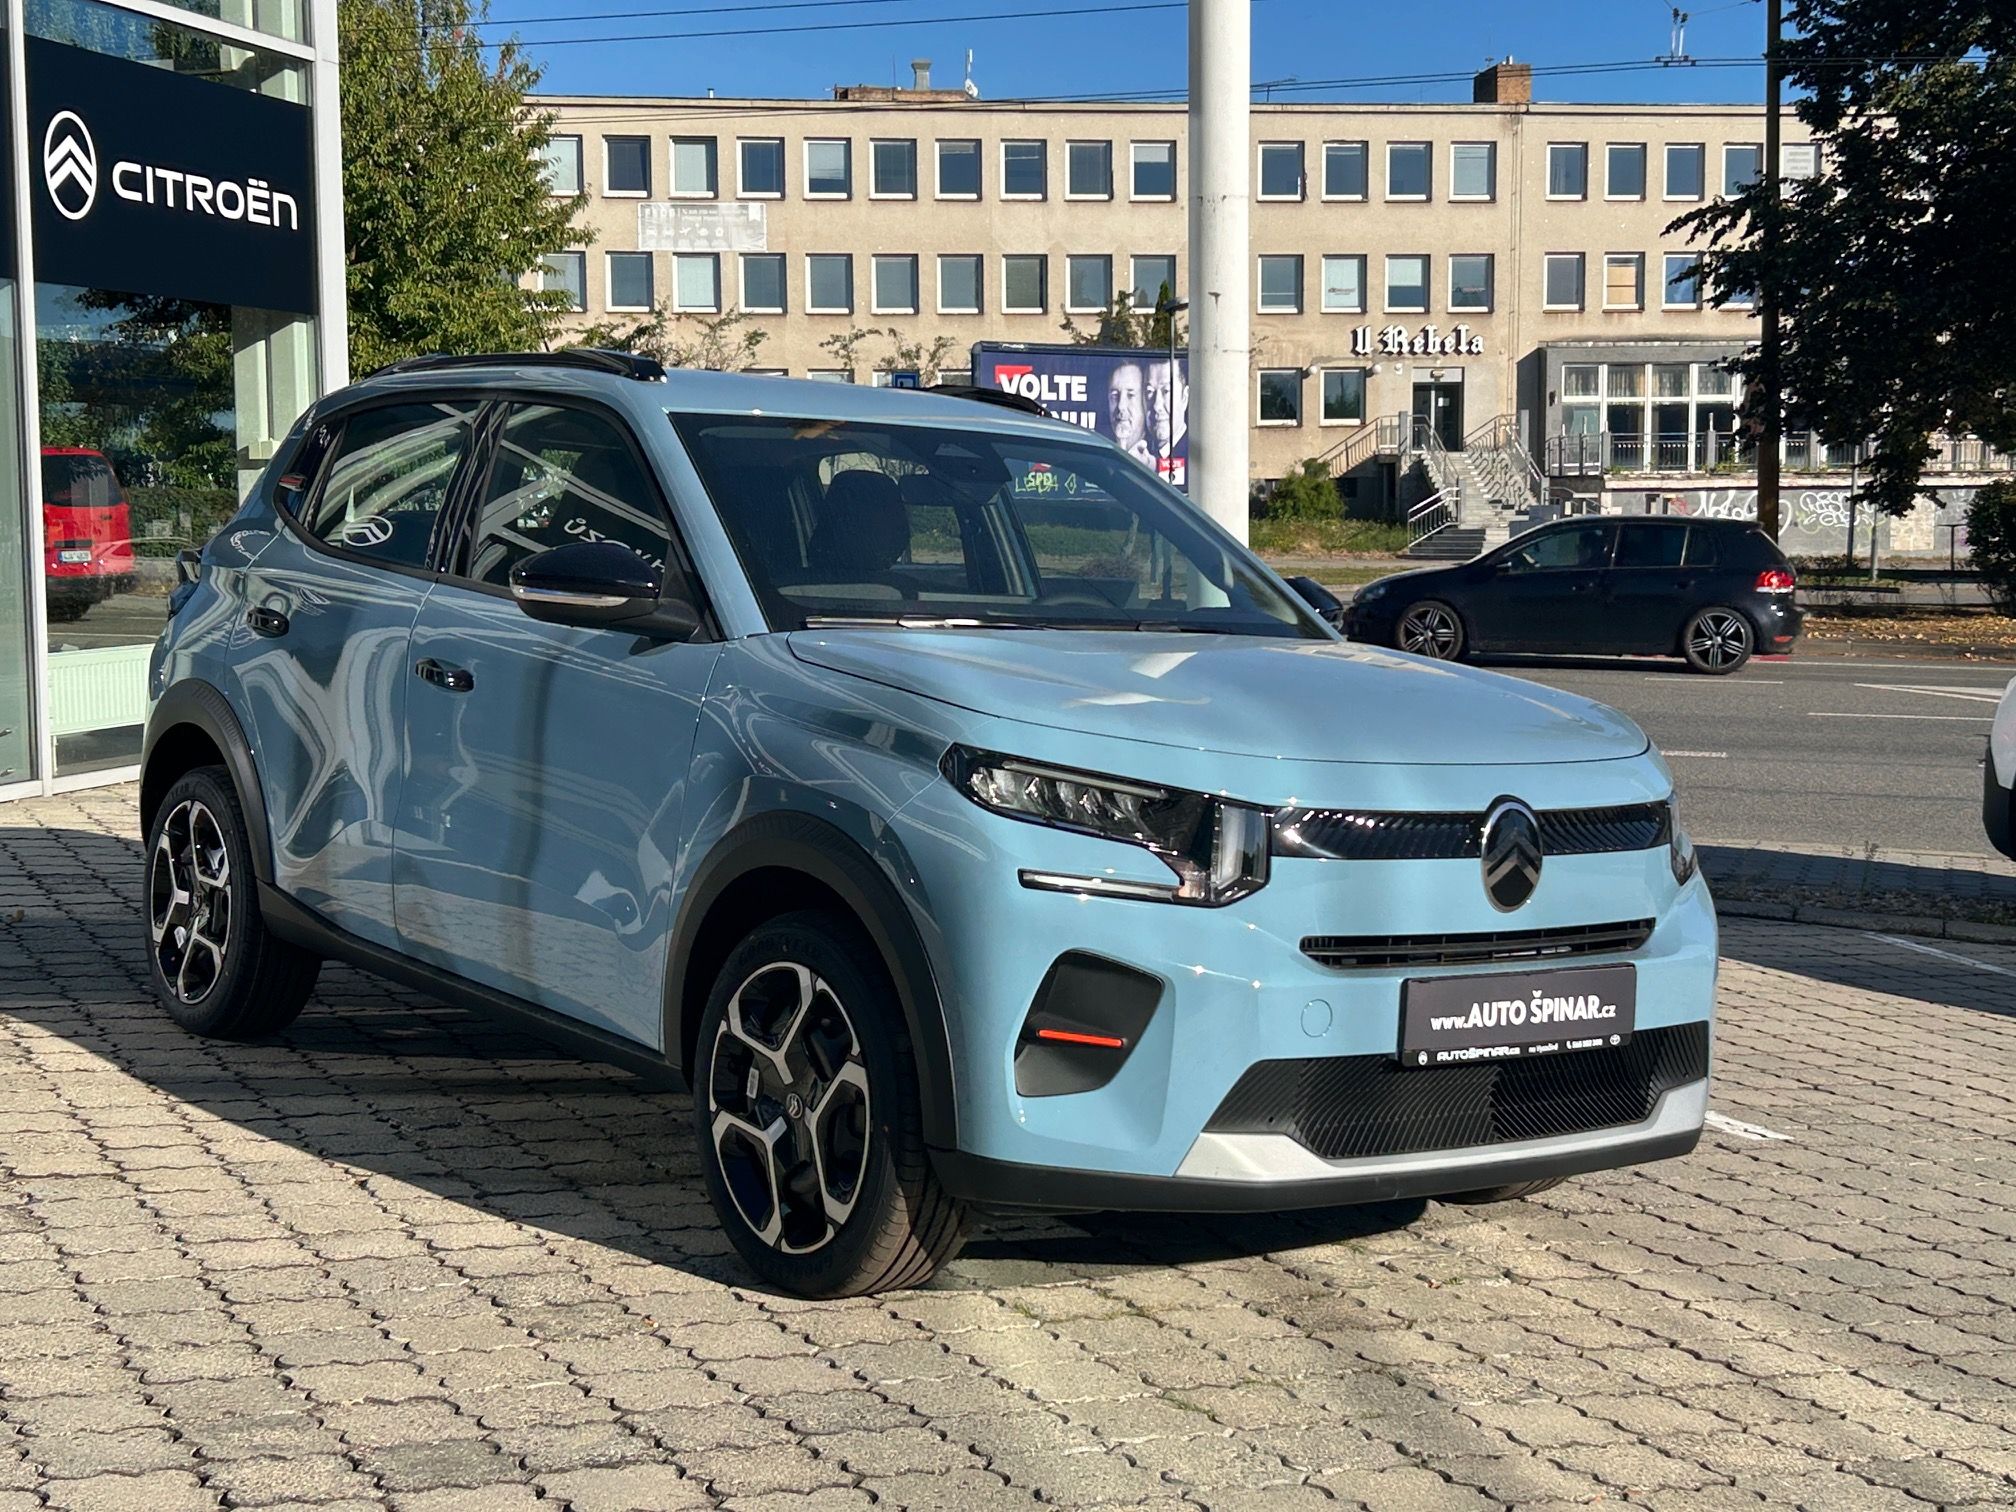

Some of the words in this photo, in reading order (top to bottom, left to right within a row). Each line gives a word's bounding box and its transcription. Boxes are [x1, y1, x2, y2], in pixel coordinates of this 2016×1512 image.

[112, 161, 298, 231] CITROËN
[1379, 323, 1485, 354] Rebela
[998, 374, 1087, 401] VOLTE
[1430, 1000, 1528, 1031] www.AUTO
[1529, 989, 1617, 1024] ŠPINAR.cz
